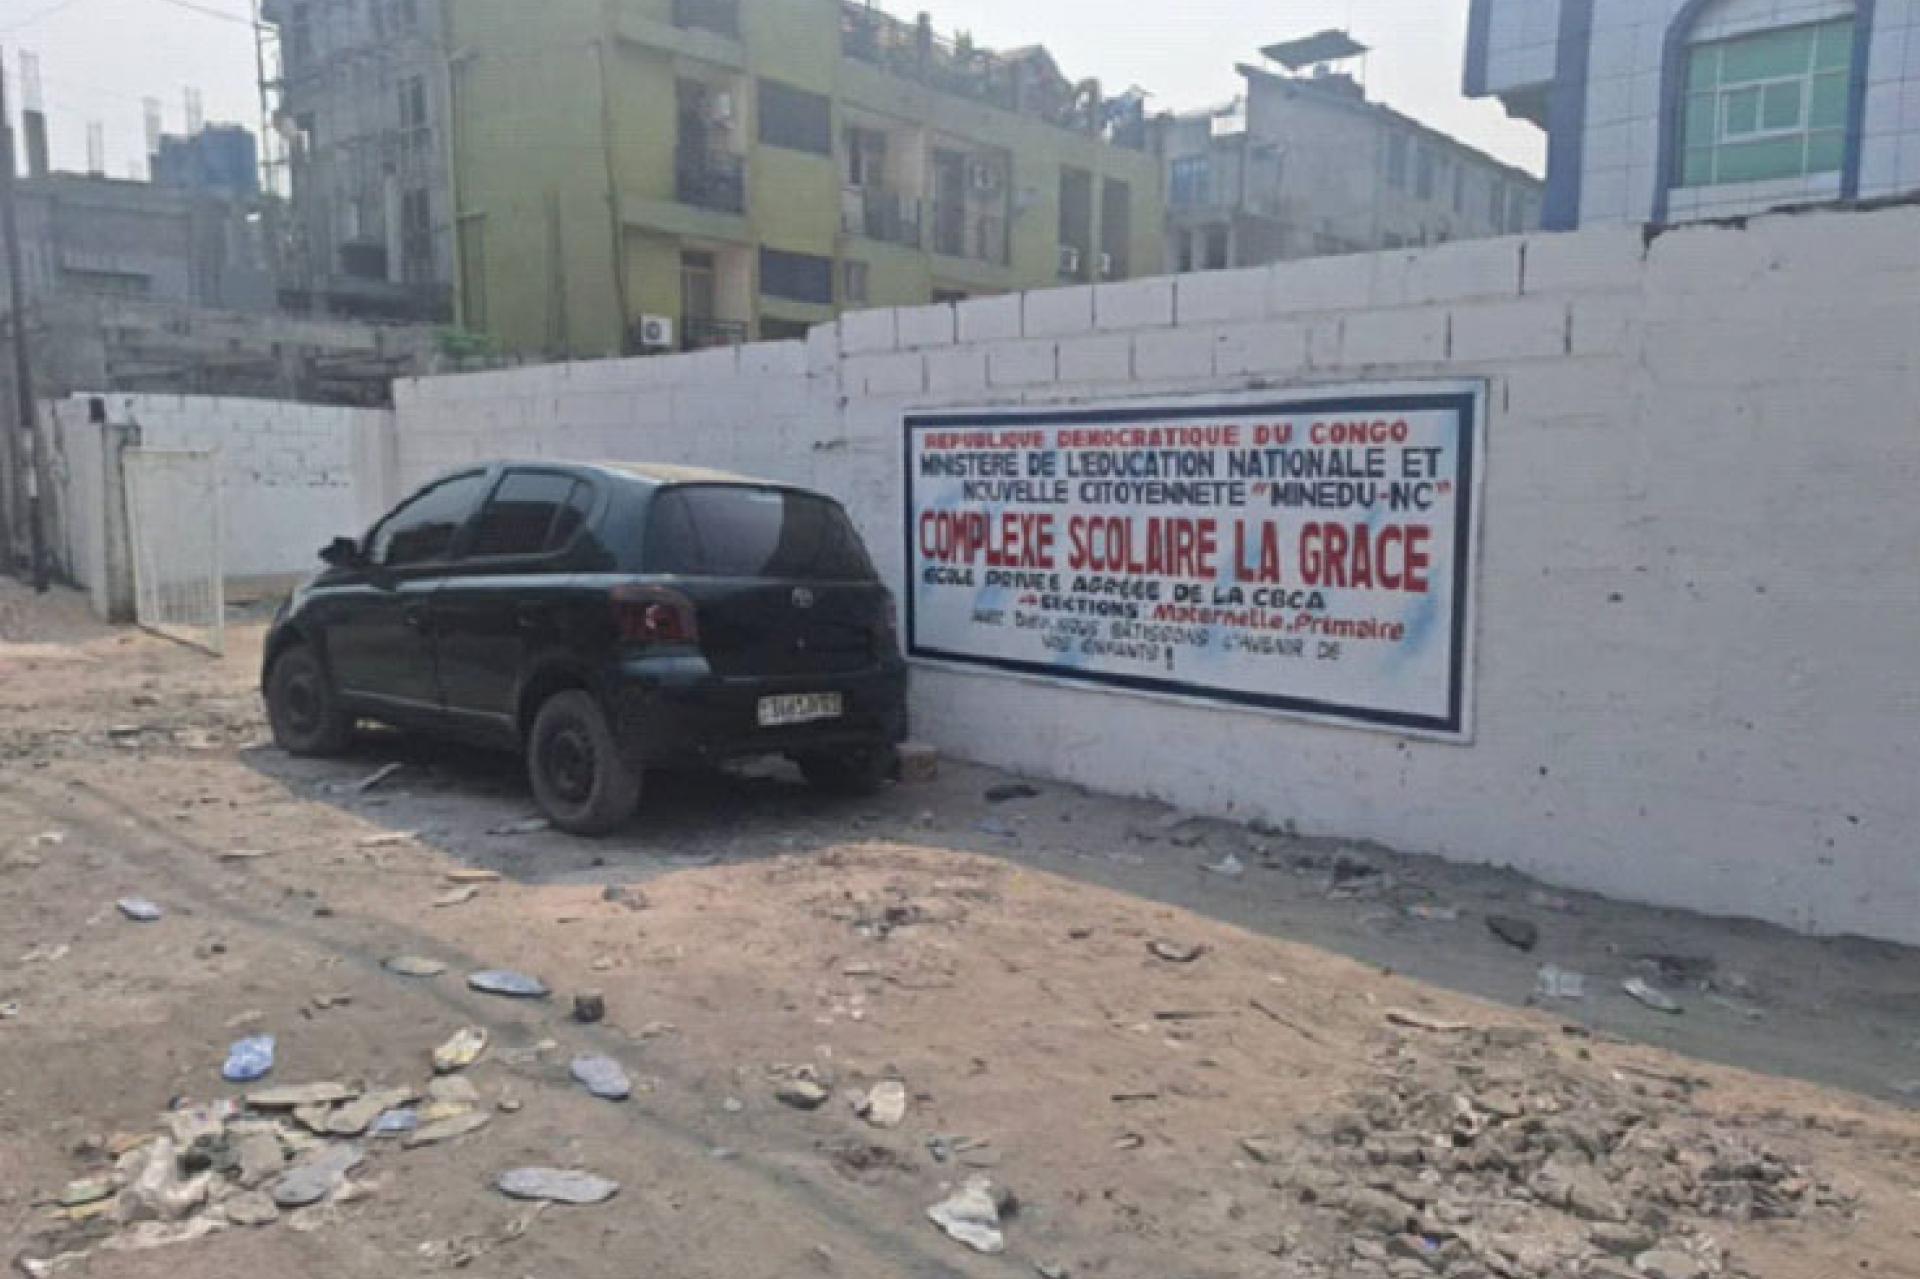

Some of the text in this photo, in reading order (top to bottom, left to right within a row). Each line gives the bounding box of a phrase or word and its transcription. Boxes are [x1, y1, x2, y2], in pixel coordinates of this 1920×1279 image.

[1056, 426, 1241, 448] DEMOCRATIQUE
[1253, 424, 1293, 446] DU
[1309, 421, 1409, 445] CONGO
[1027, 452, 1057, 477] DE
[1227, 448, 1387, 478] NATIONALE
[1402, 446, 1443, 478] ET
[962, 479, 1069, 503] NOUVELLE
[1079, 480, 1247, 506] CITOYENNETE
[918, 510, 1431, 593] COMPLEXE SCOLAIRE LA GRACE
[1173, 583, 1203, 604] DE
[1213, 585, 1244, 606] LA
